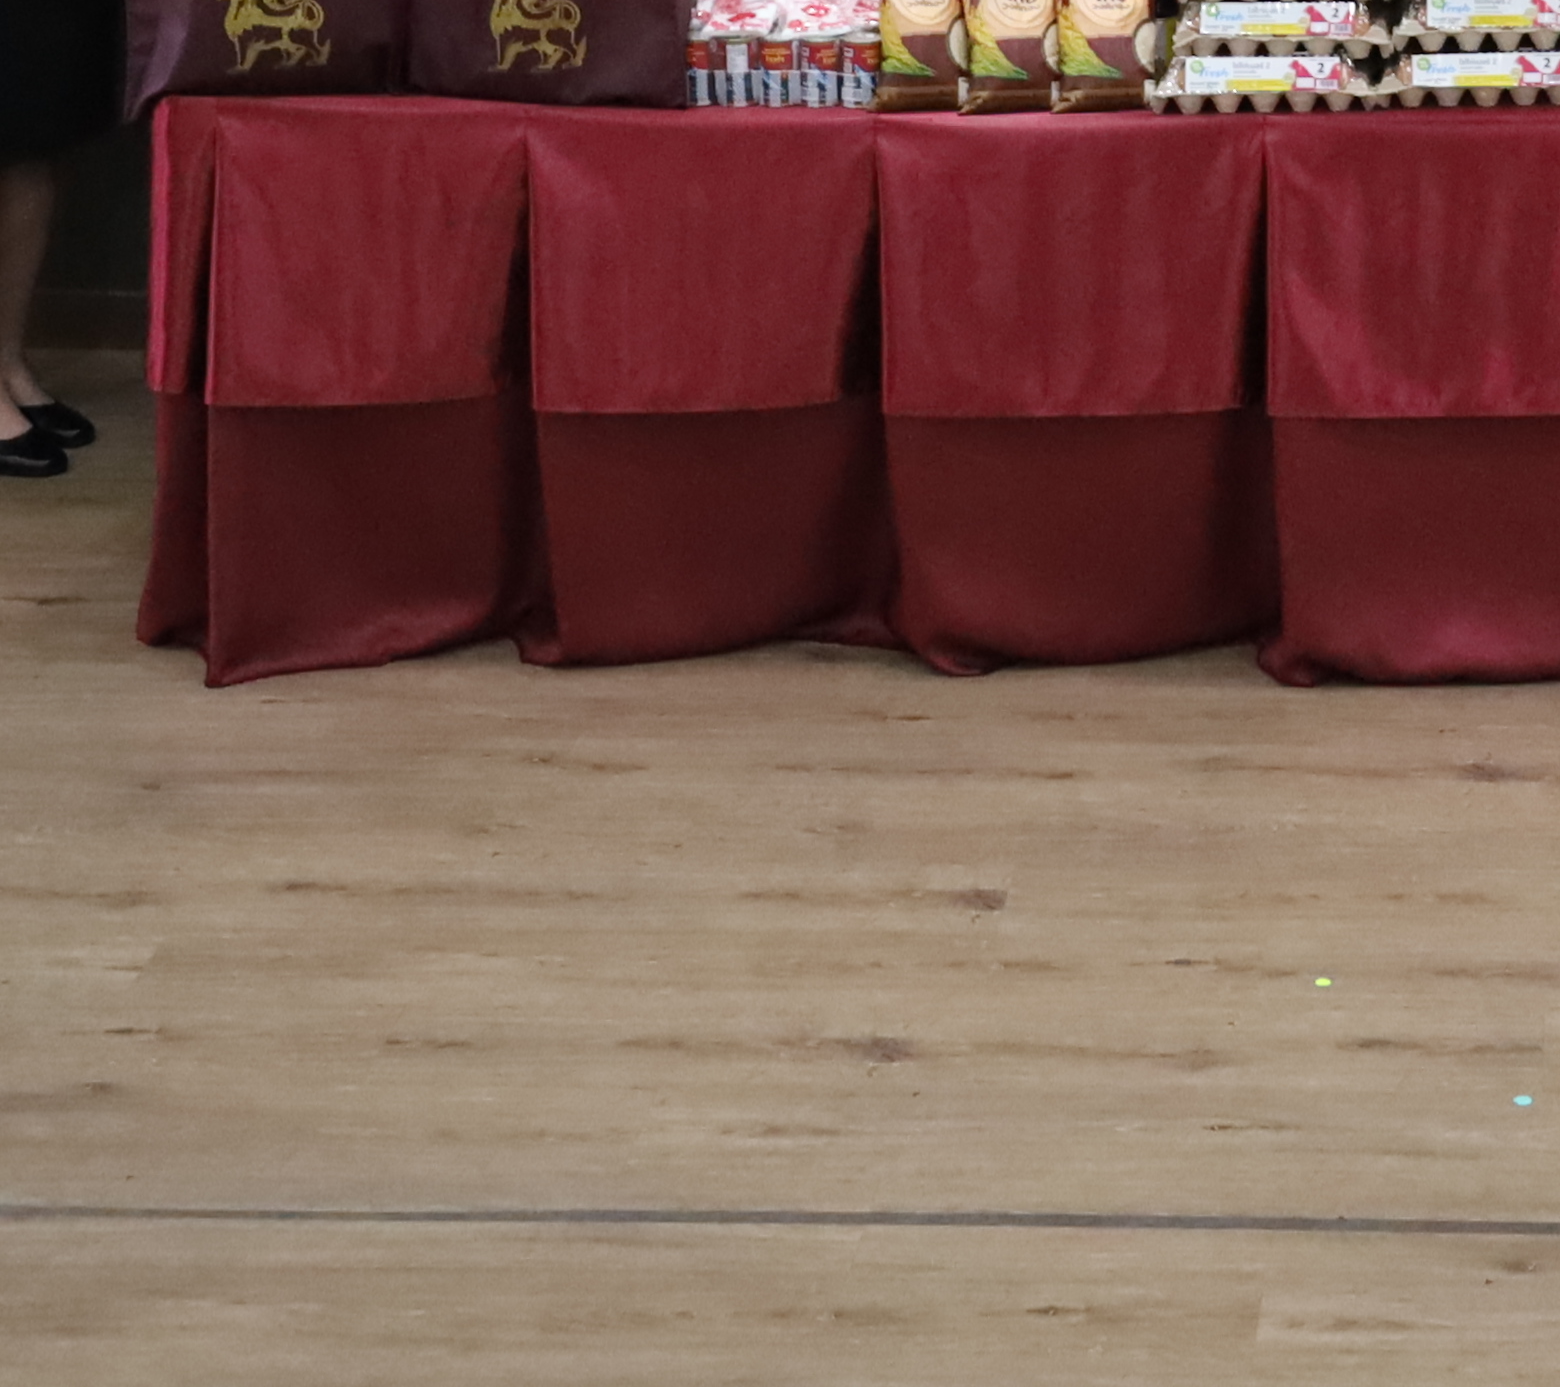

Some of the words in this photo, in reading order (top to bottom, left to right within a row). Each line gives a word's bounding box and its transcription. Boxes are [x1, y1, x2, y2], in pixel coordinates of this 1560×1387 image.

[1331, 8, 1340, 19] 2
[1316, 62, 1325, 73] 2
[1543, 57, 1551, 68] 2
